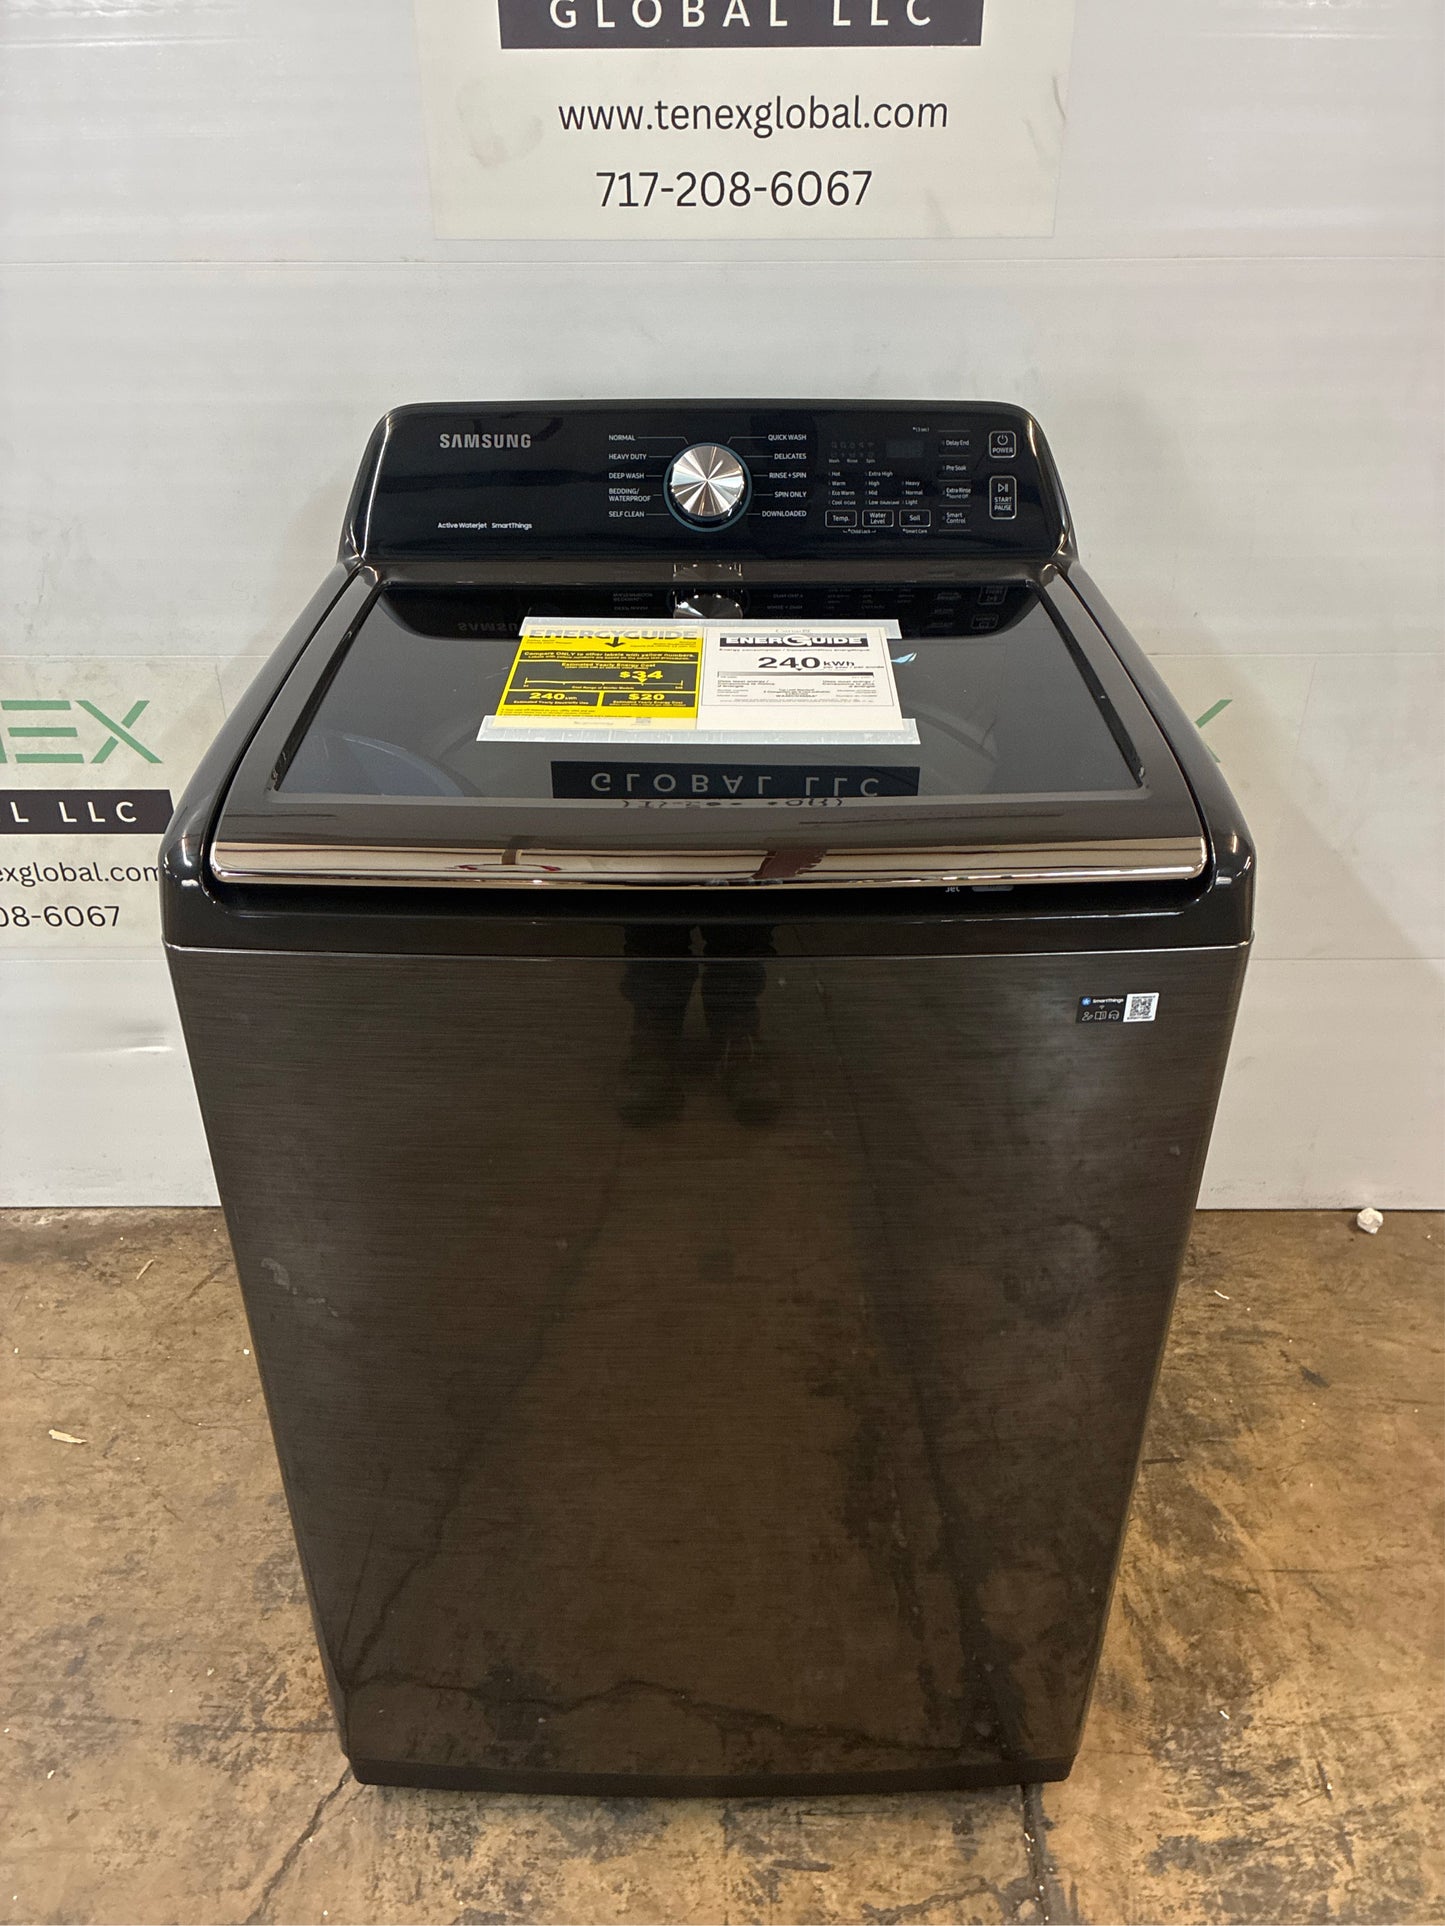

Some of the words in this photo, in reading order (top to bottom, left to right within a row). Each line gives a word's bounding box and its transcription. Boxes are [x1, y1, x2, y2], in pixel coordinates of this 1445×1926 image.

[549, 0, 788, 28] GLOBAL
[832, 0, 931, 27] LLC
[558, 95, 949, 138] www.tenexglobal.com
[595, 170, 873, 208] 717-208-6067
[439, 433, 531, 449] SAMSUNG
[491, 522, 533, 530] SmartThings
[529, 629, 697, 640] ENERGYGUIDE
[725, 634, 862, 647] ENERGUIDE
[758, 656, 820, 668] 240
[619, 670, 664, 680] $34
[529, 692, 565, 700] 240
[628, 693, 665, 701] $20
[0, 700, 163, 764] EX
[58, 801, 137, 823] LLC
[0, 862, 158, 887] xglobal.com
